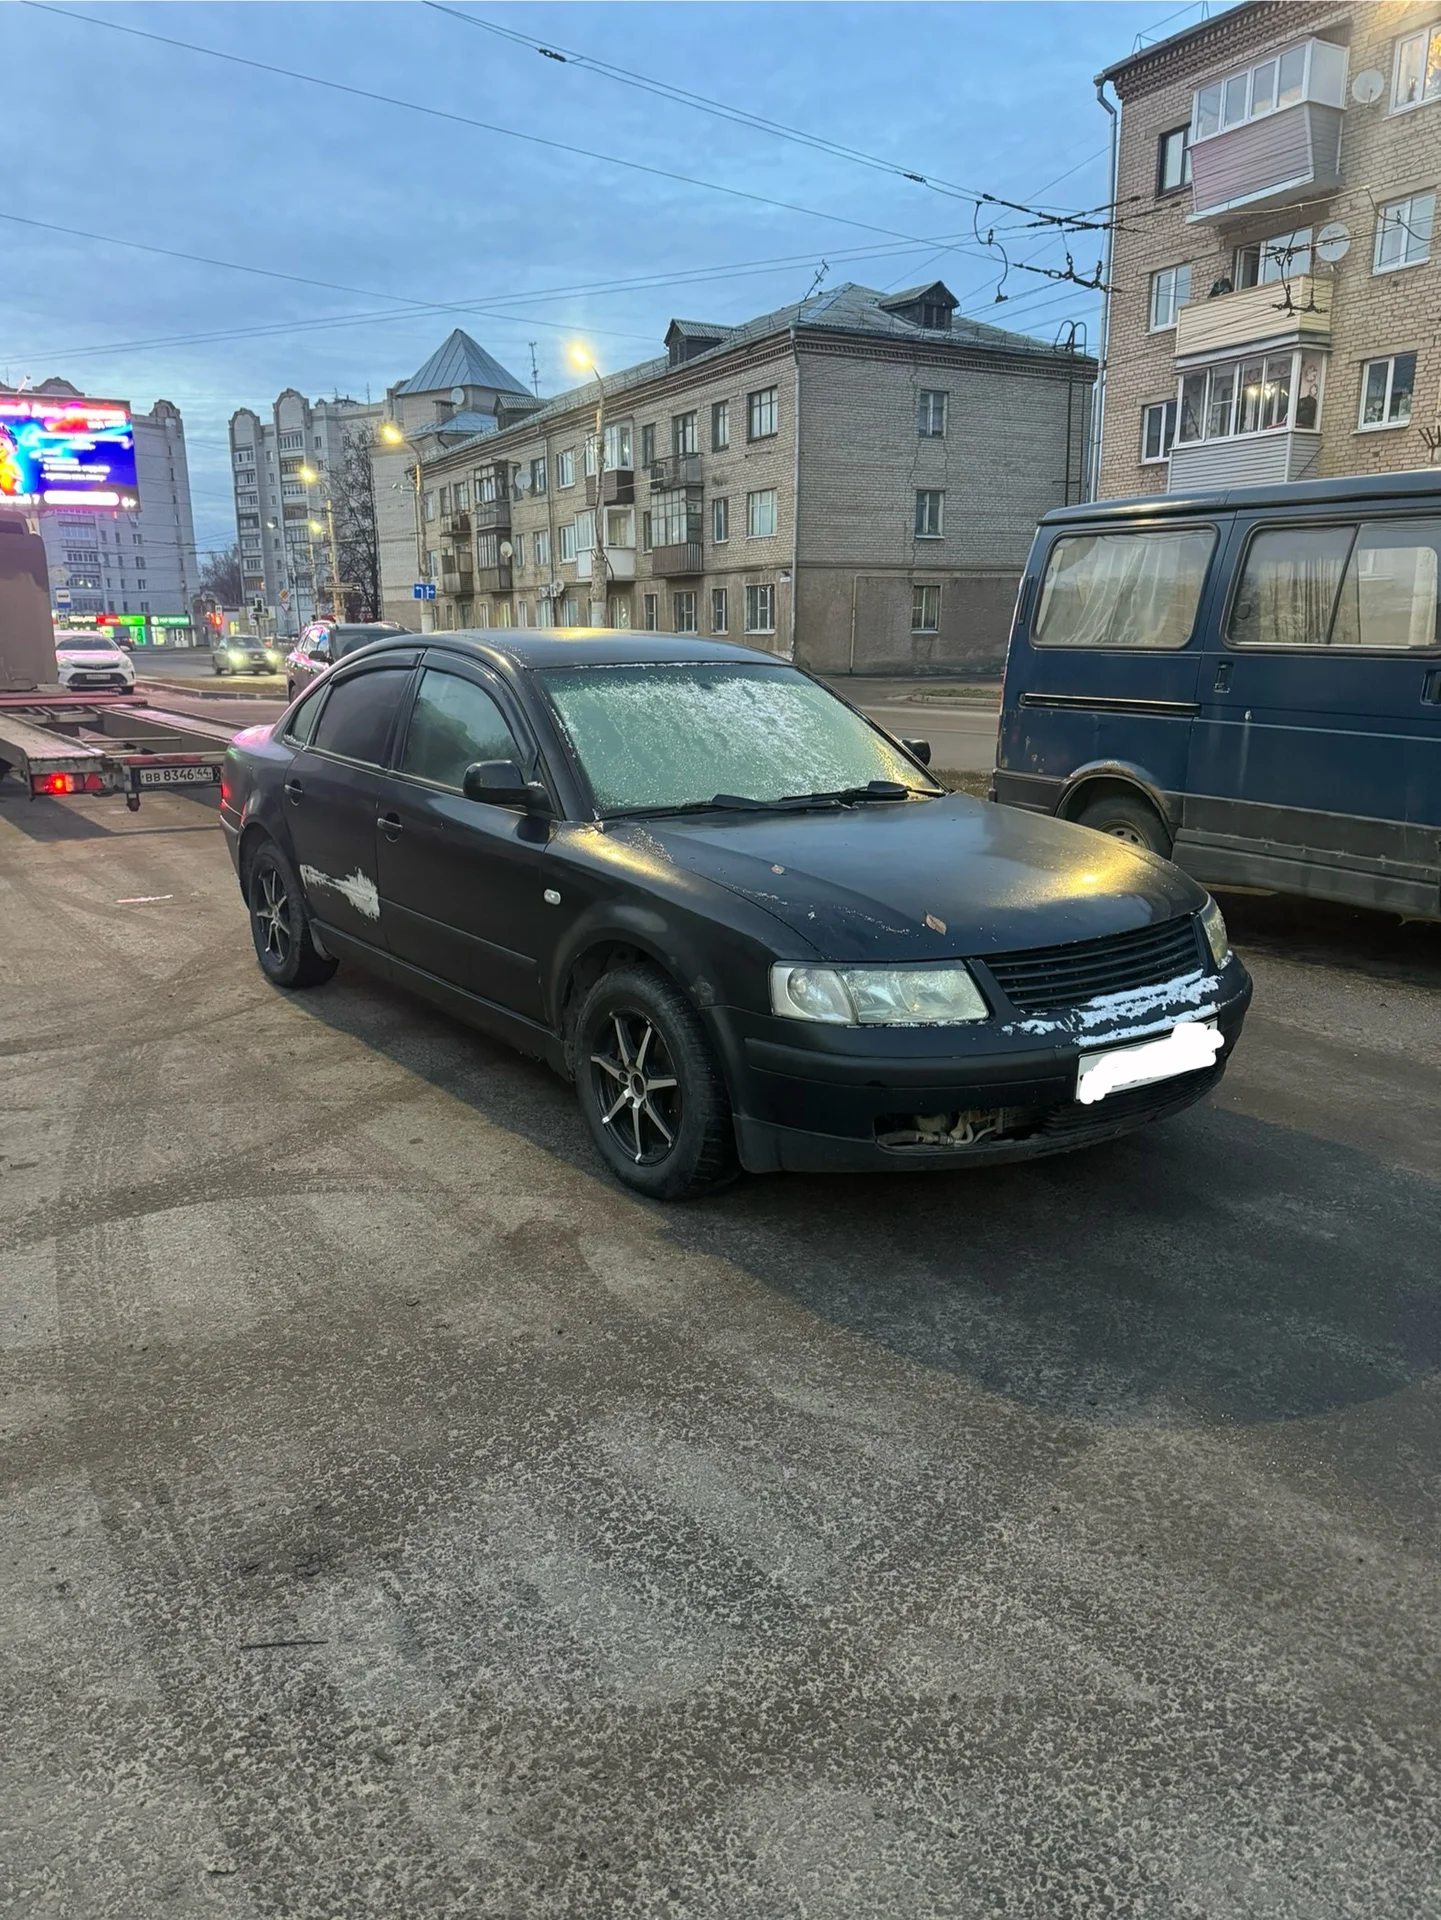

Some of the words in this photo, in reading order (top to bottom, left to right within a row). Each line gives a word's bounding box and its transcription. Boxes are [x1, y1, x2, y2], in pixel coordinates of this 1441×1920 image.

[145, 773, 160, 782] ВВ
[163, 769, 194, 781] 8346
[197, 768, 209, 776] 44
